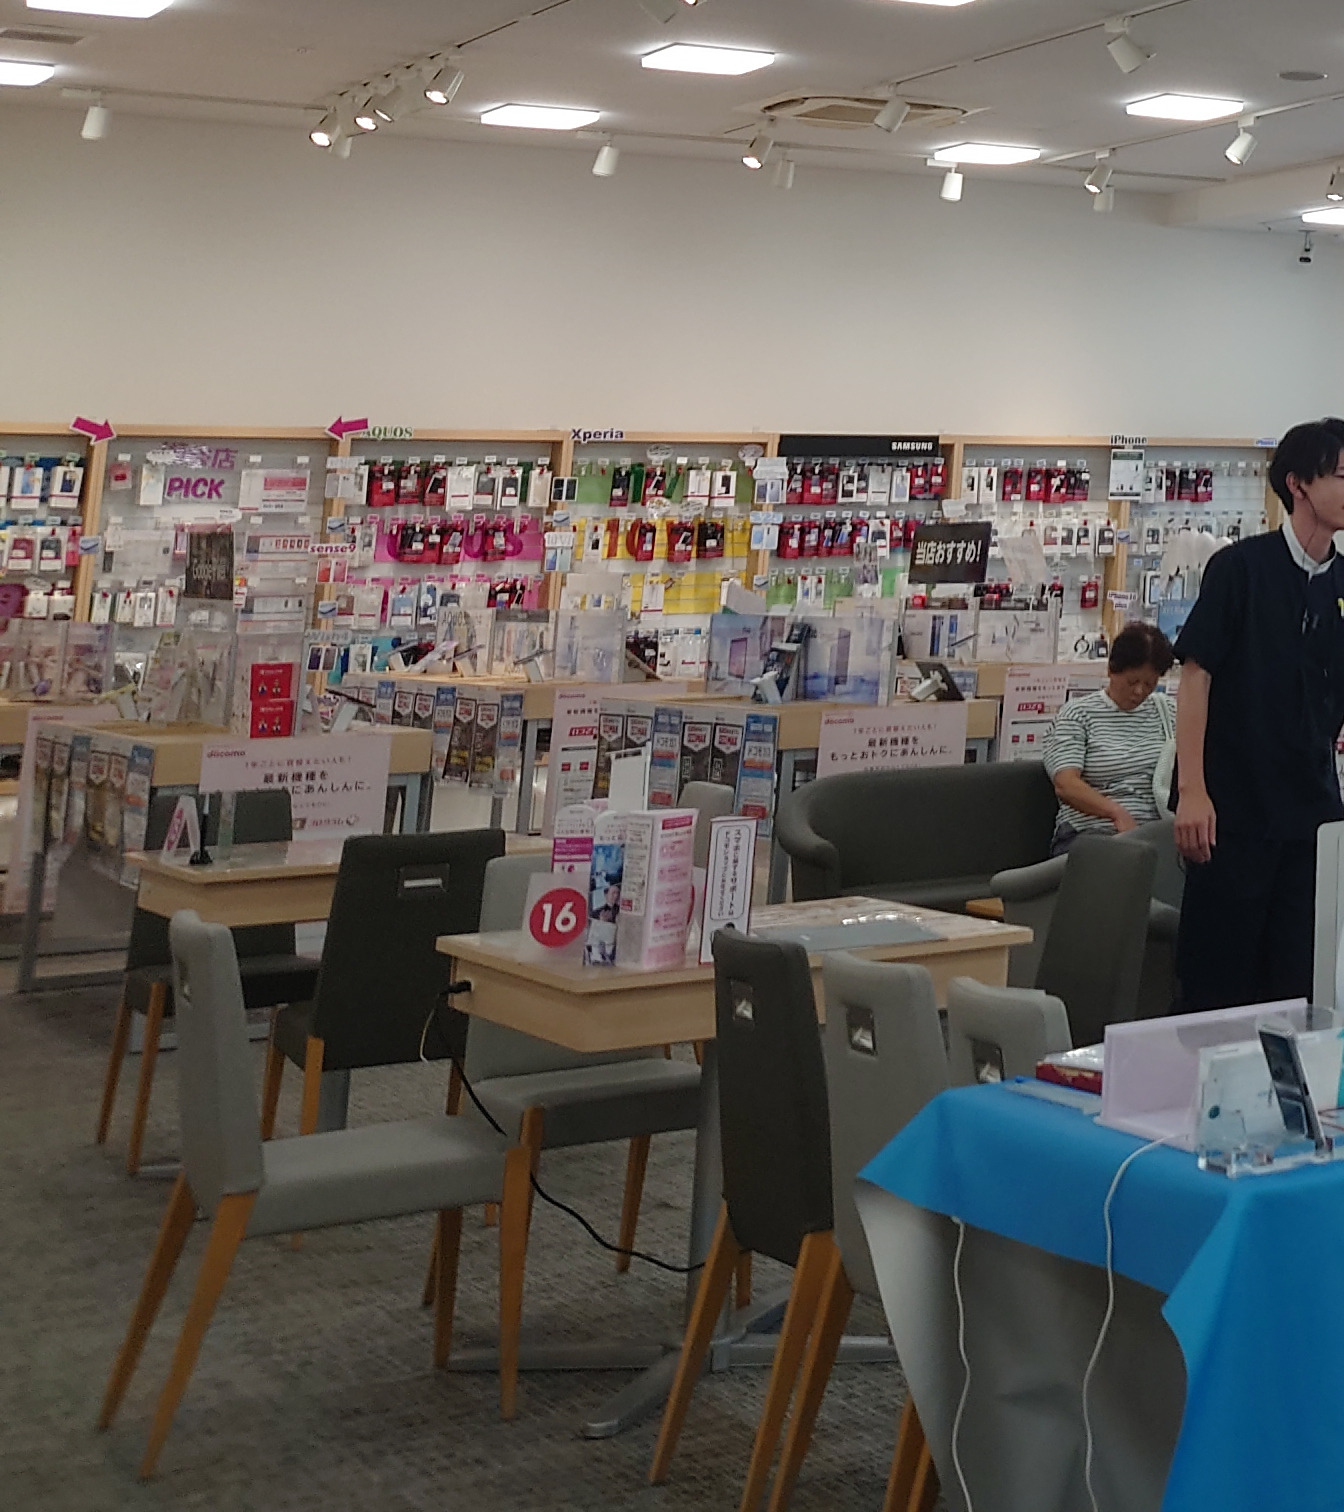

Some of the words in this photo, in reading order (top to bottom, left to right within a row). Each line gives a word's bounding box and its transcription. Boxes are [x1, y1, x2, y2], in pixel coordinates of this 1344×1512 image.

[571, 428, 624, 442] Xperia
[1110, 435, 1147, 446] iPhone
[891, 442, 934, 452] SAMSUNG
[166, 477, 225, 499] PICK
[915, 538, 981, 565] 当店おすすめ!
[541, 901, 577, 933] 16
